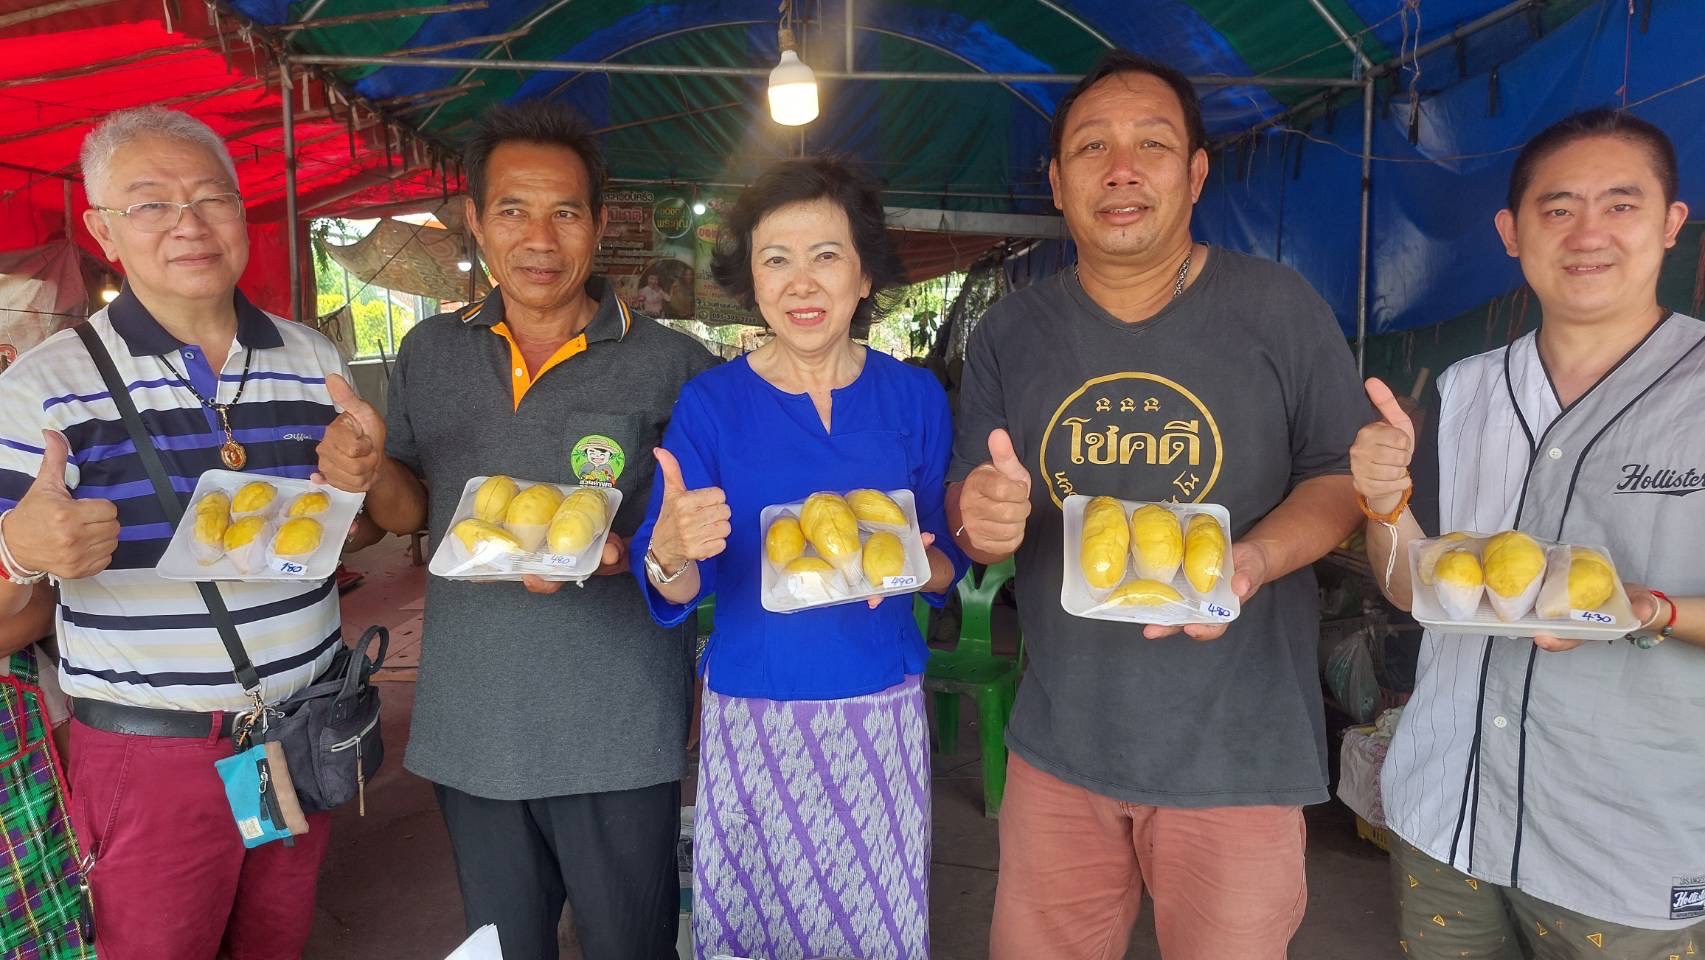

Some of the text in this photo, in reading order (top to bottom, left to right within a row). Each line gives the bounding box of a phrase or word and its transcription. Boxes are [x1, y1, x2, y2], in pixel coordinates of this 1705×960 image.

[1061, 417, 1201, 465] โชคดี
[891, 576, 914, 587] 490
[1582, 611, 1612, 623] 430
